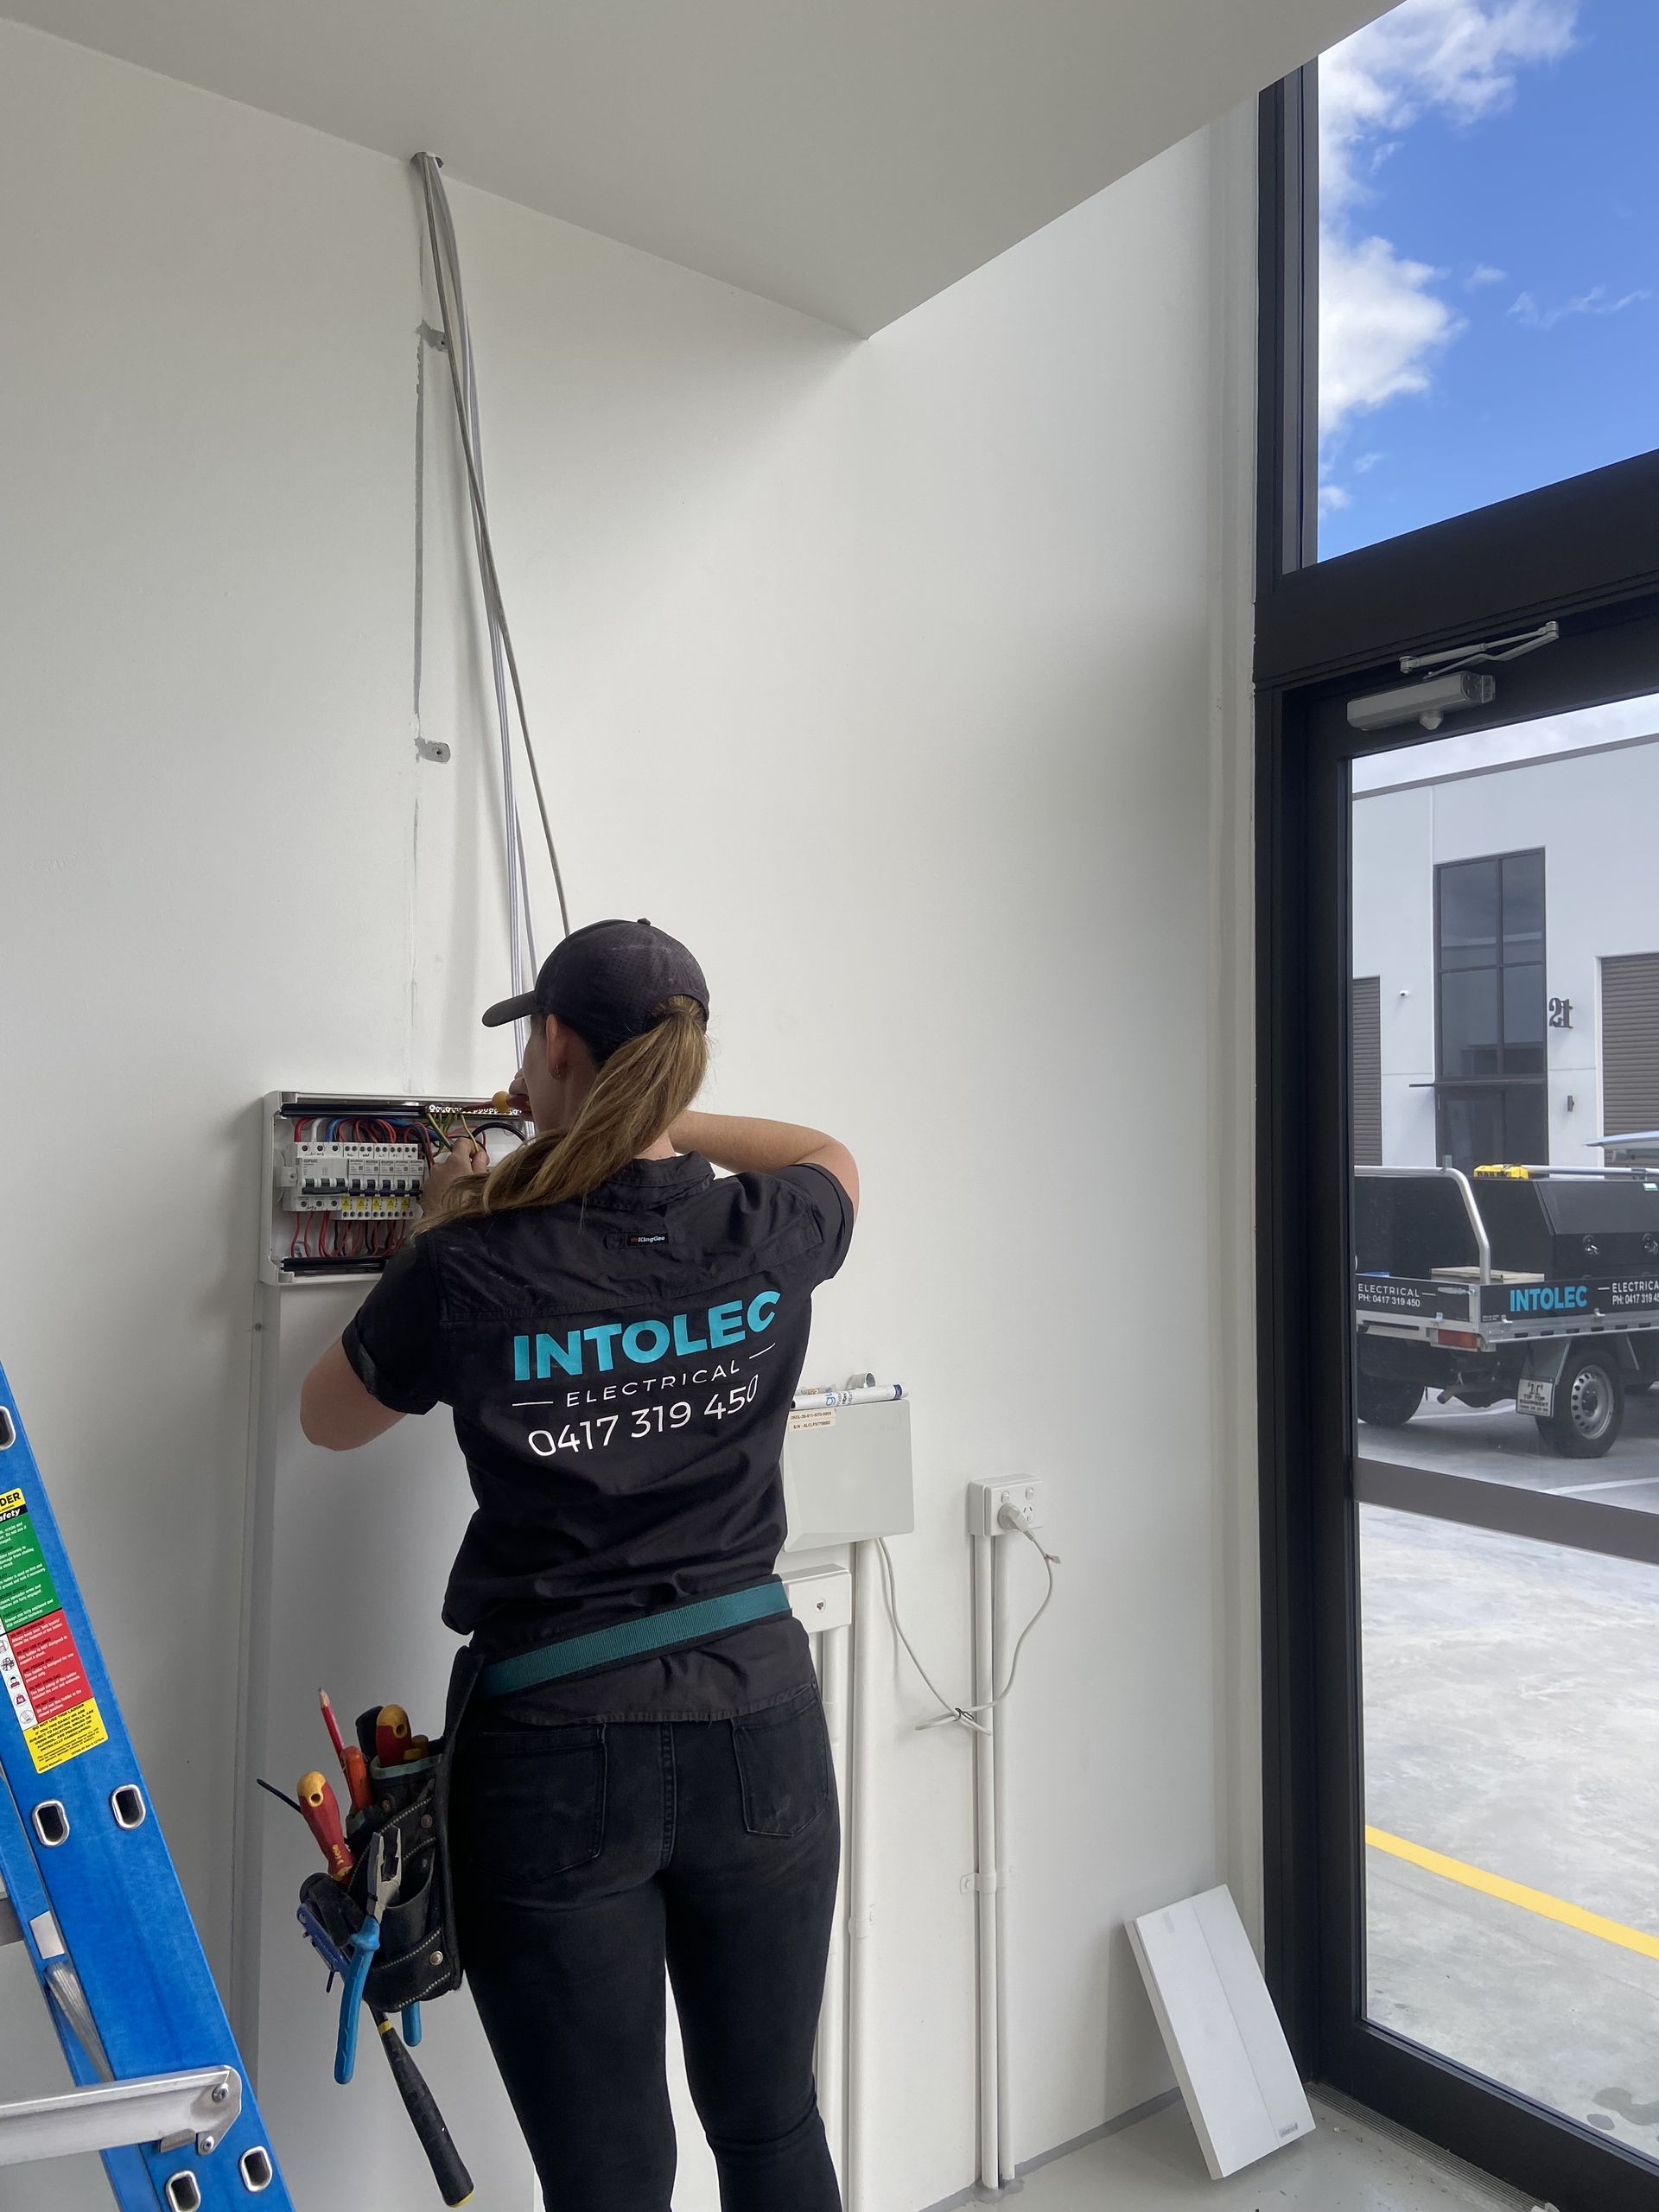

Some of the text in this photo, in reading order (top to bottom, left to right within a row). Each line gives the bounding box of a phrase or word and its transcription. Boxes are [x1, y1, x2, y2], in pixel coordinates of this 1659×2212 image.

[1549, 998, 1573, 1028] 21
[1358, 1283, 1420, 1297] ELECTRICAL
[1358, 1293, 1421, 1307] PH: 0417 319 450
[1510, 1286, 1588, 1312] INTOLEC
[1612, 1294, 1624, 1306] PH:
[1625, 1294, 1640, 1305] 0417
[1641, 1293, 1652, 1304] 319
[514, 1291, 781, 1381] INTOLEC
[567, 1359, 741, 1408] ELECTRICAL
[528, 1374, 759, 1457] 0417 319 450
